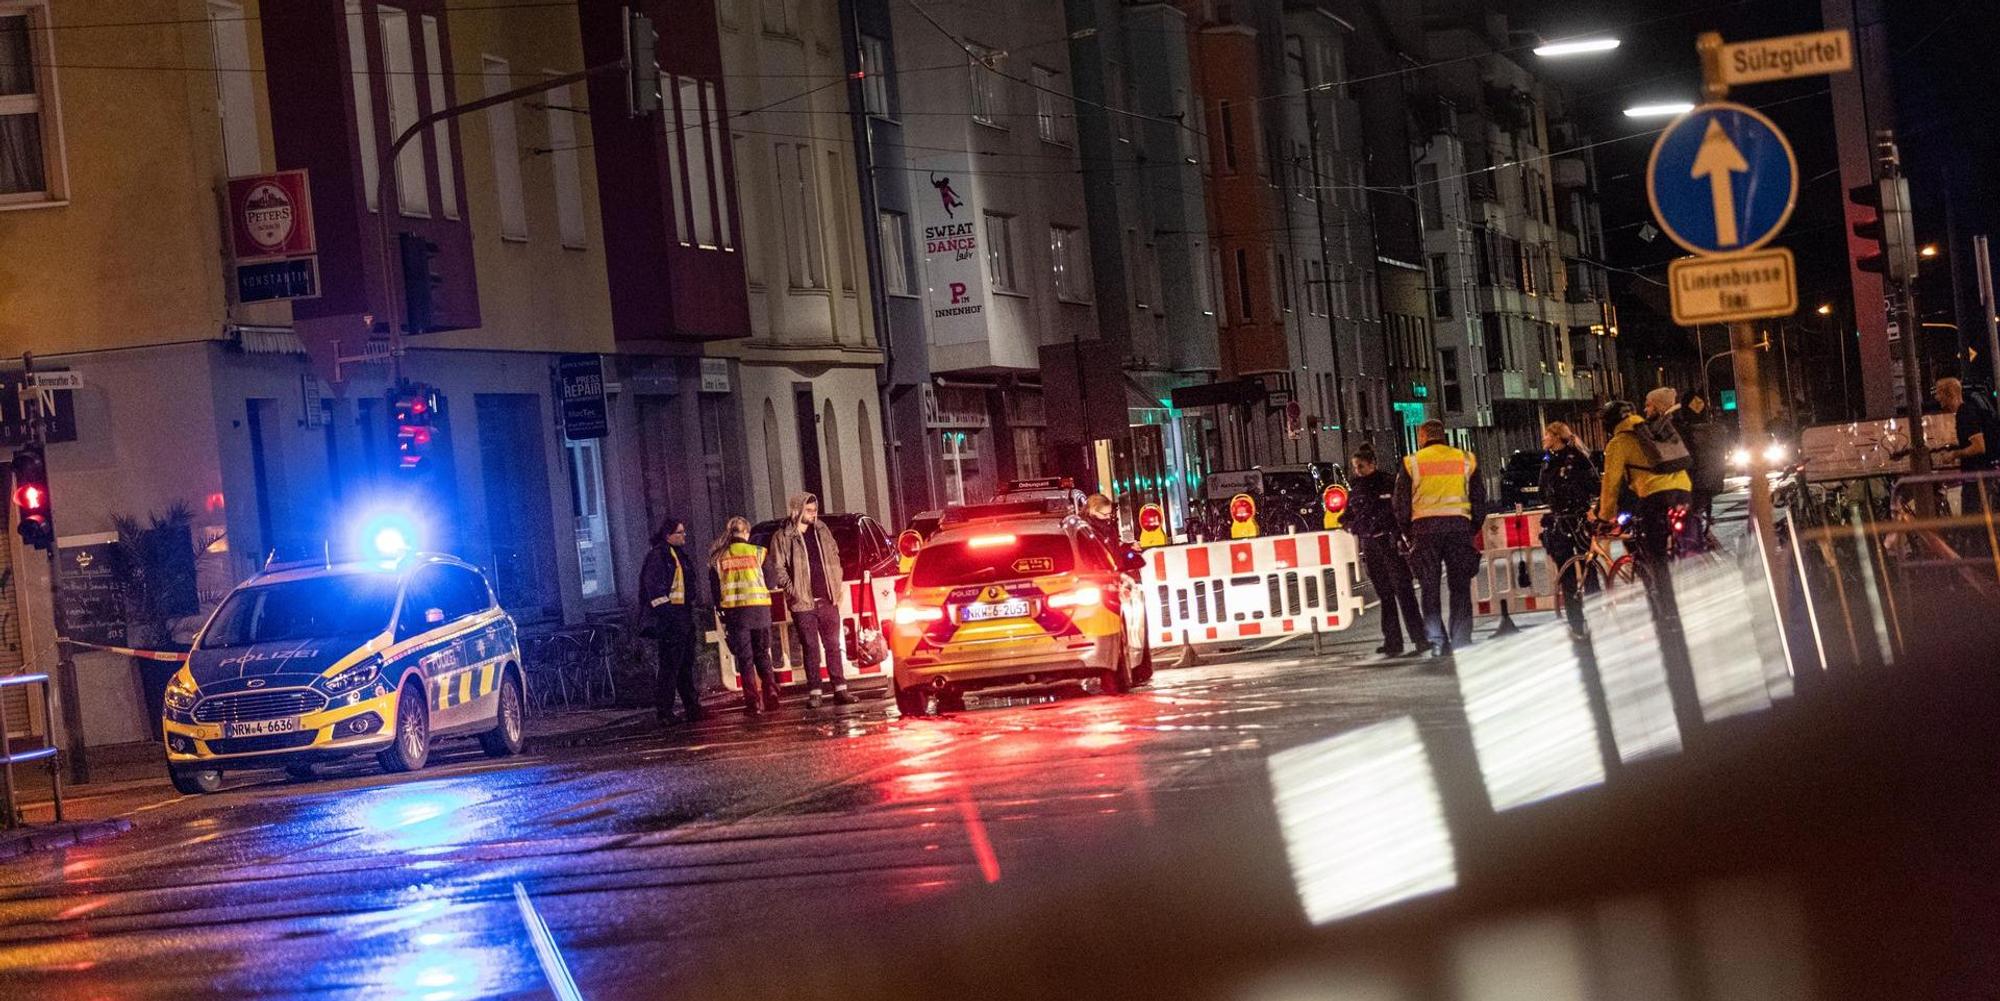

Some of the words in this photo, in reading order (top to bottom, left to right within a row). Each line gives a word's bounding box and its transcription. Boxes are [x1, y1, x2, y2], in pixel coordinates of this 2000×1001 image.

[1733, 37, 1842, 73] Sülzgürtel
[248, 207, 290, 223] PETERS
[925, 223, 973, 238] SWEAT
[927, 238, 975, 254] DANCE
[242, 271, 309, 287] KONSTANTIN
[1681, 267, 1781, 291] Linienbusse
[949, 282, 967, 304] P
[961, 296, 970, 304] IM
[935, 305, 982, 318] INNENHOF
[564, 383, 601, 398] REPAIR
[951, 589, 980, 598] POLIZEI
[219, 649, 319, 667] POLIZEI
[232, 724, 251, 736] NRW
[256, 720, 293, 733] 4-6636
